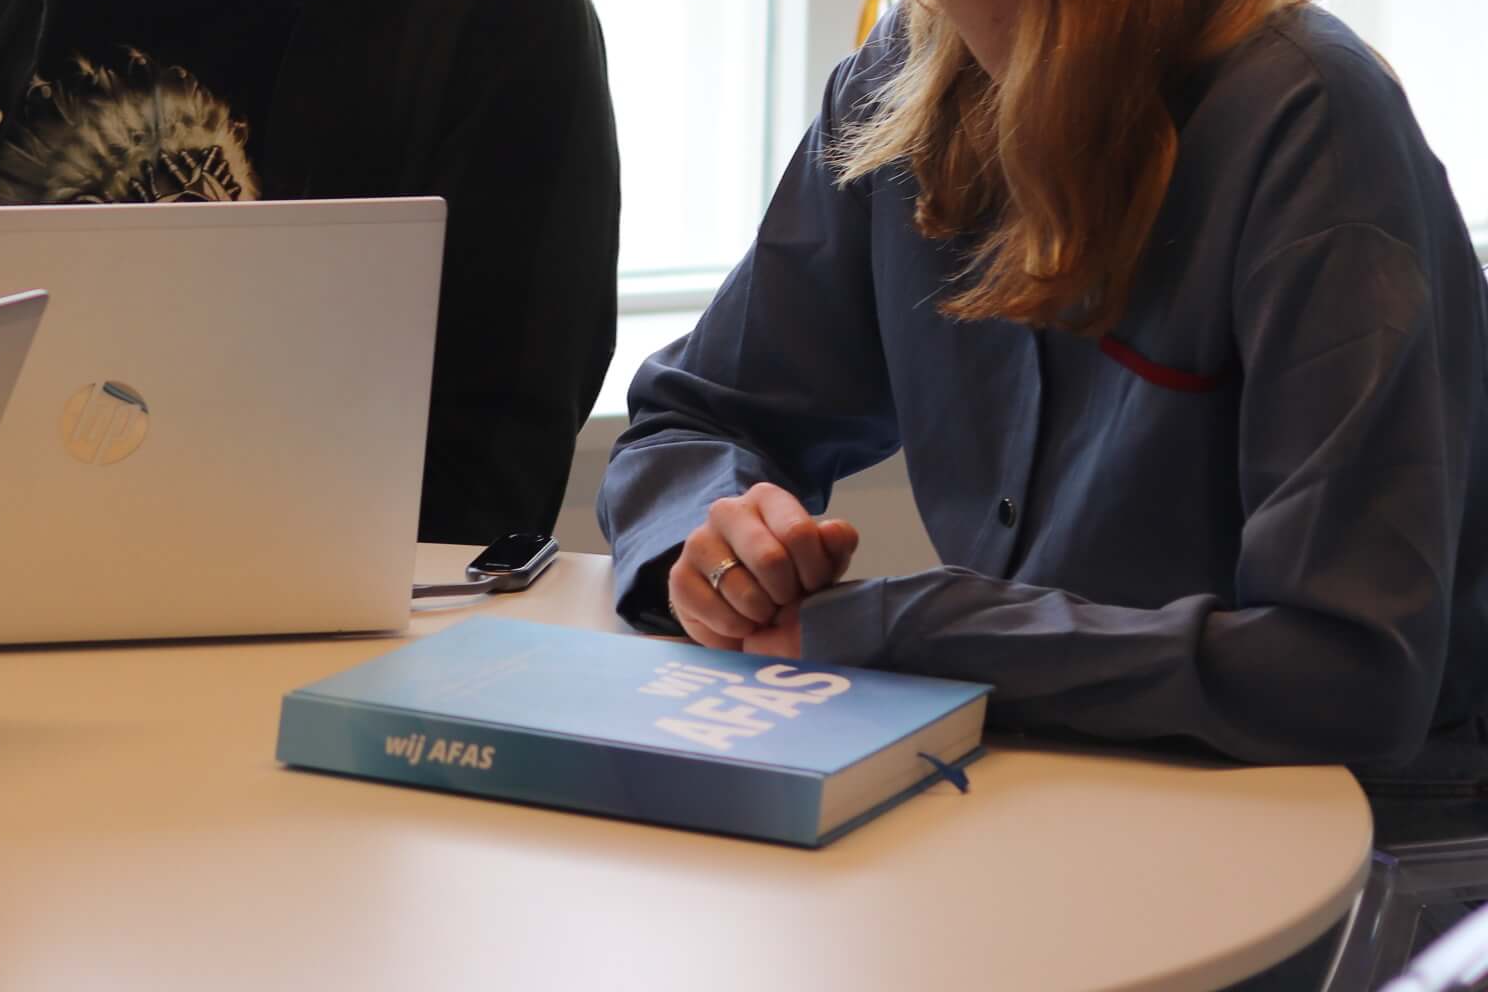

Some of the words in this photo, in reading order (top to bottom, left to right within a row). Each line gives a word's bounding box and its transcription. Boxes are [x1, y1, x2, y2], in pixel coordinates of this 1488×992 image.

[638, 661, 744, 698] wij
[655, 664, 851, 751] AFAS
[385, 733, 426, 766] wij
[427, 739, 496, 770] AFAS
